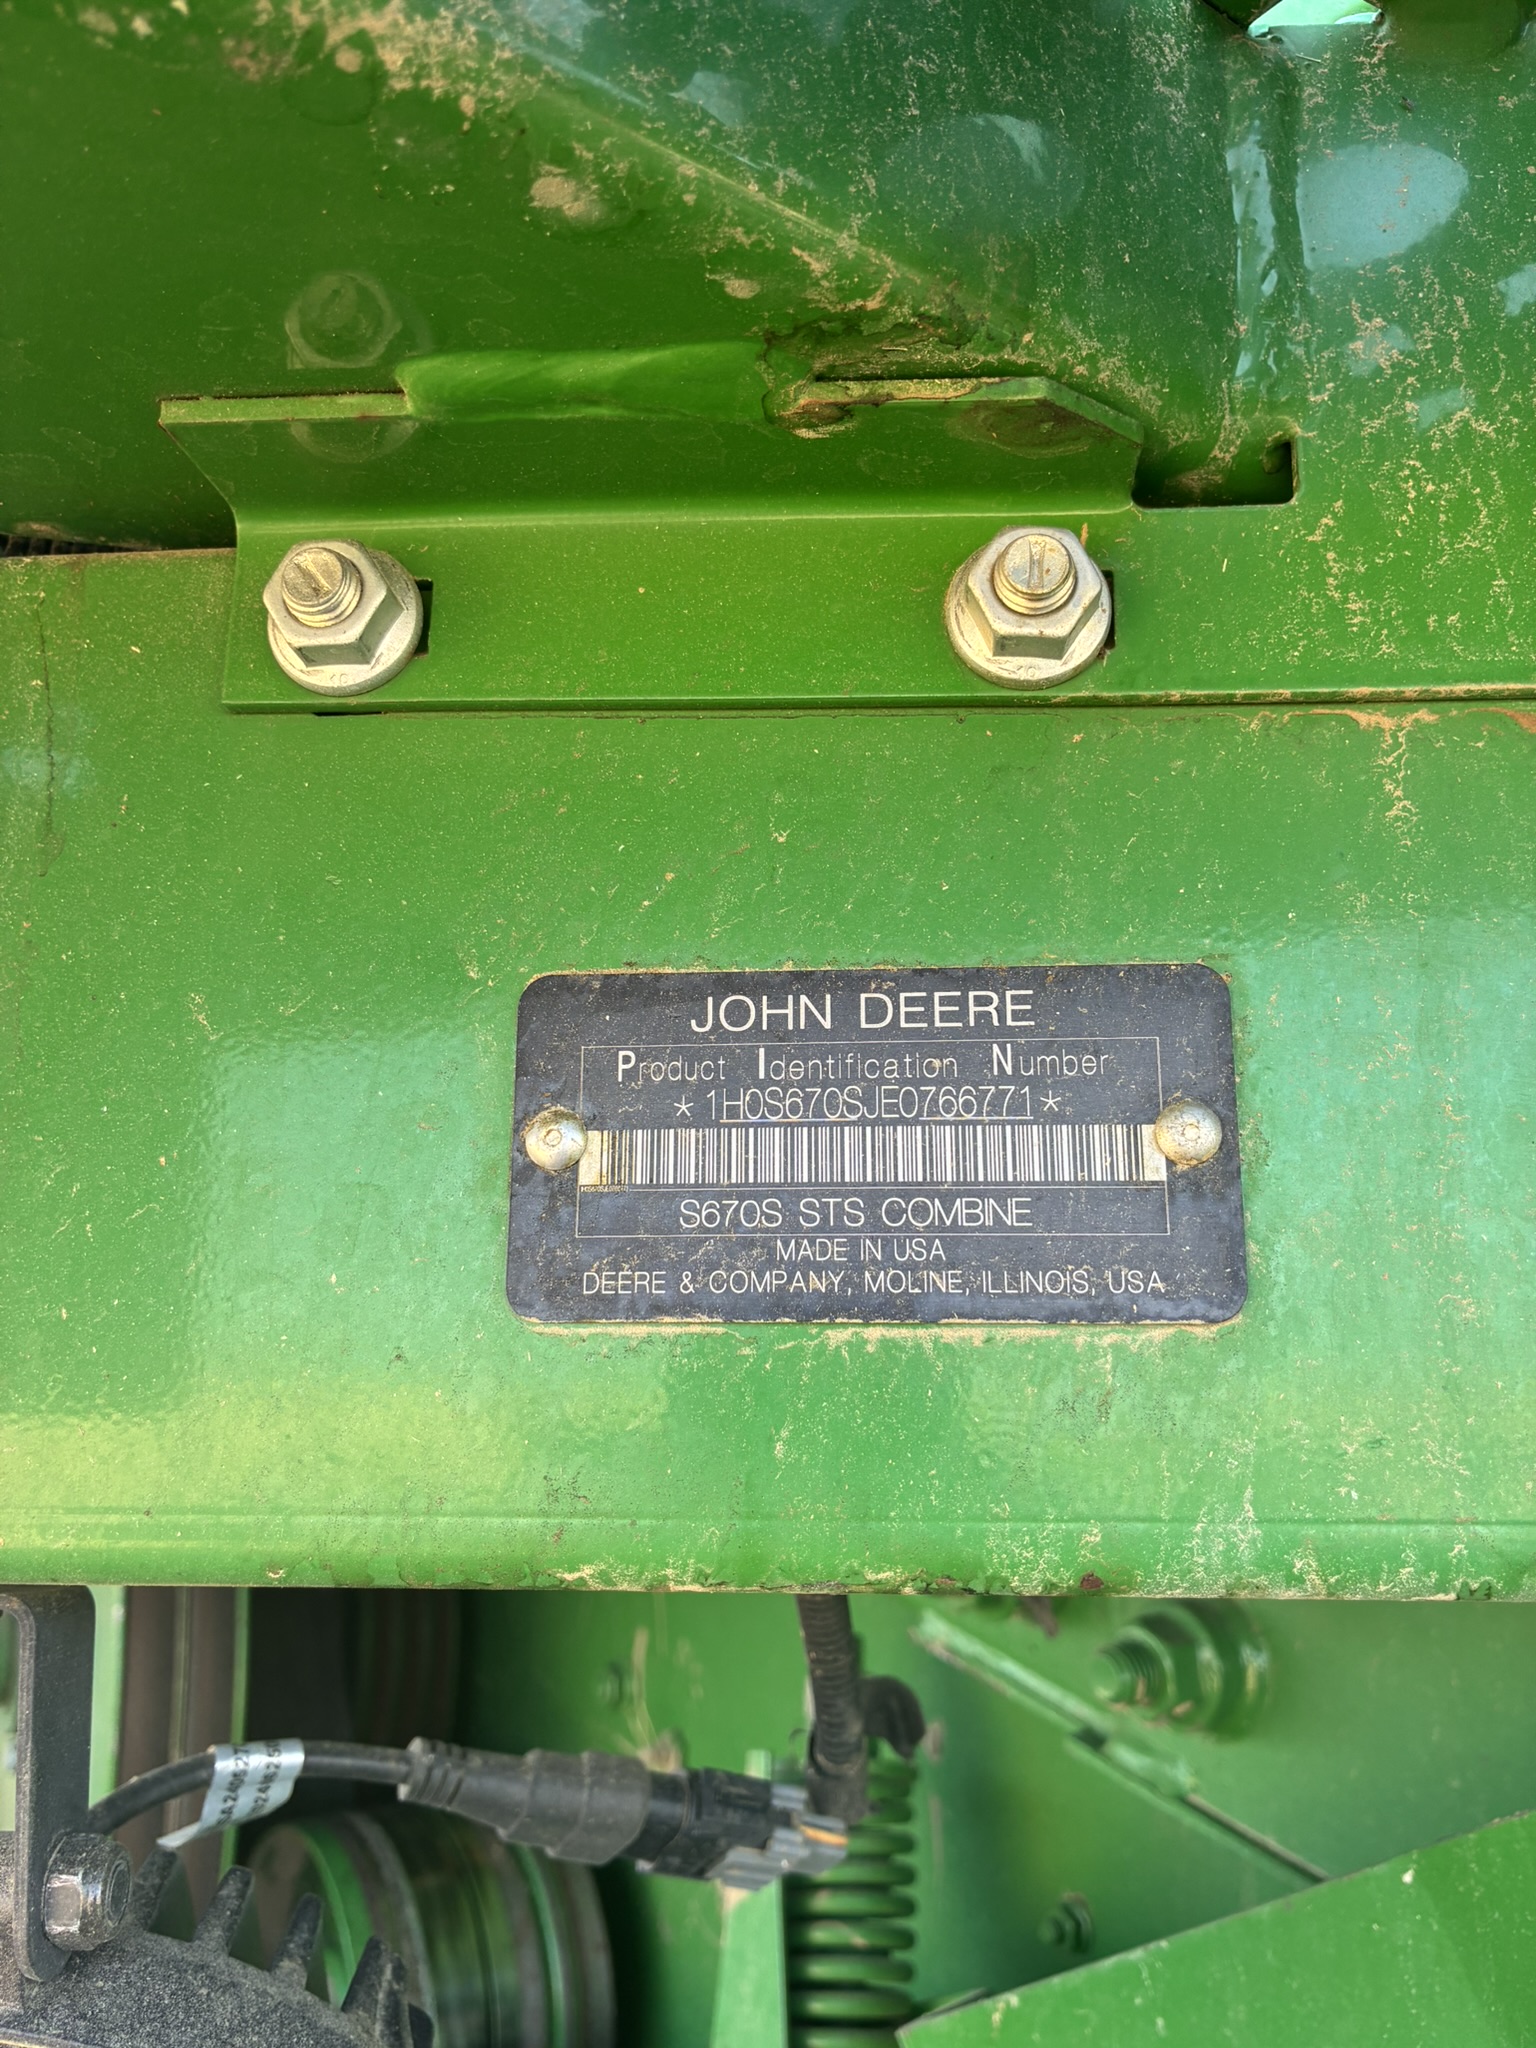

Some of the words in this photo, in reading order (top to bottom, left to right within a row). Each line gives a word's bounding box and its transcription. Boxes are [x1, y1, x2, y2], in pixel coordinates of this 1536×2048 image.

[690, 993, 832, 1033] JOHN
[859, 989, 1035, 1031] DEERE
[617, 1050, 726, 1083] Product
[758, 1046, 958, 1081] Identification
[992, 1043, 1109, 1077] Number
[679, 1198, 782, 1228] S670S
[799, 1198, 865, 1227] STS
[882, 1197, 1033, 1227] COMBINE
[776, 1238, 848, 1262] MADE
[860, 1239, 882, 1261] IN
[893, 1238, 946, 1261] USA
[582, 1271, 666, 1295] DEERE
[679, 1271, 695, 1294] &
[709, 1270, 852, 1296] COMPANY,
[864, 1270, 970, 1296] MOLINE,
[982, 1270, 1096, 1296] ILLINOIS,
[1109, 1270, 1165, 1294] USA
